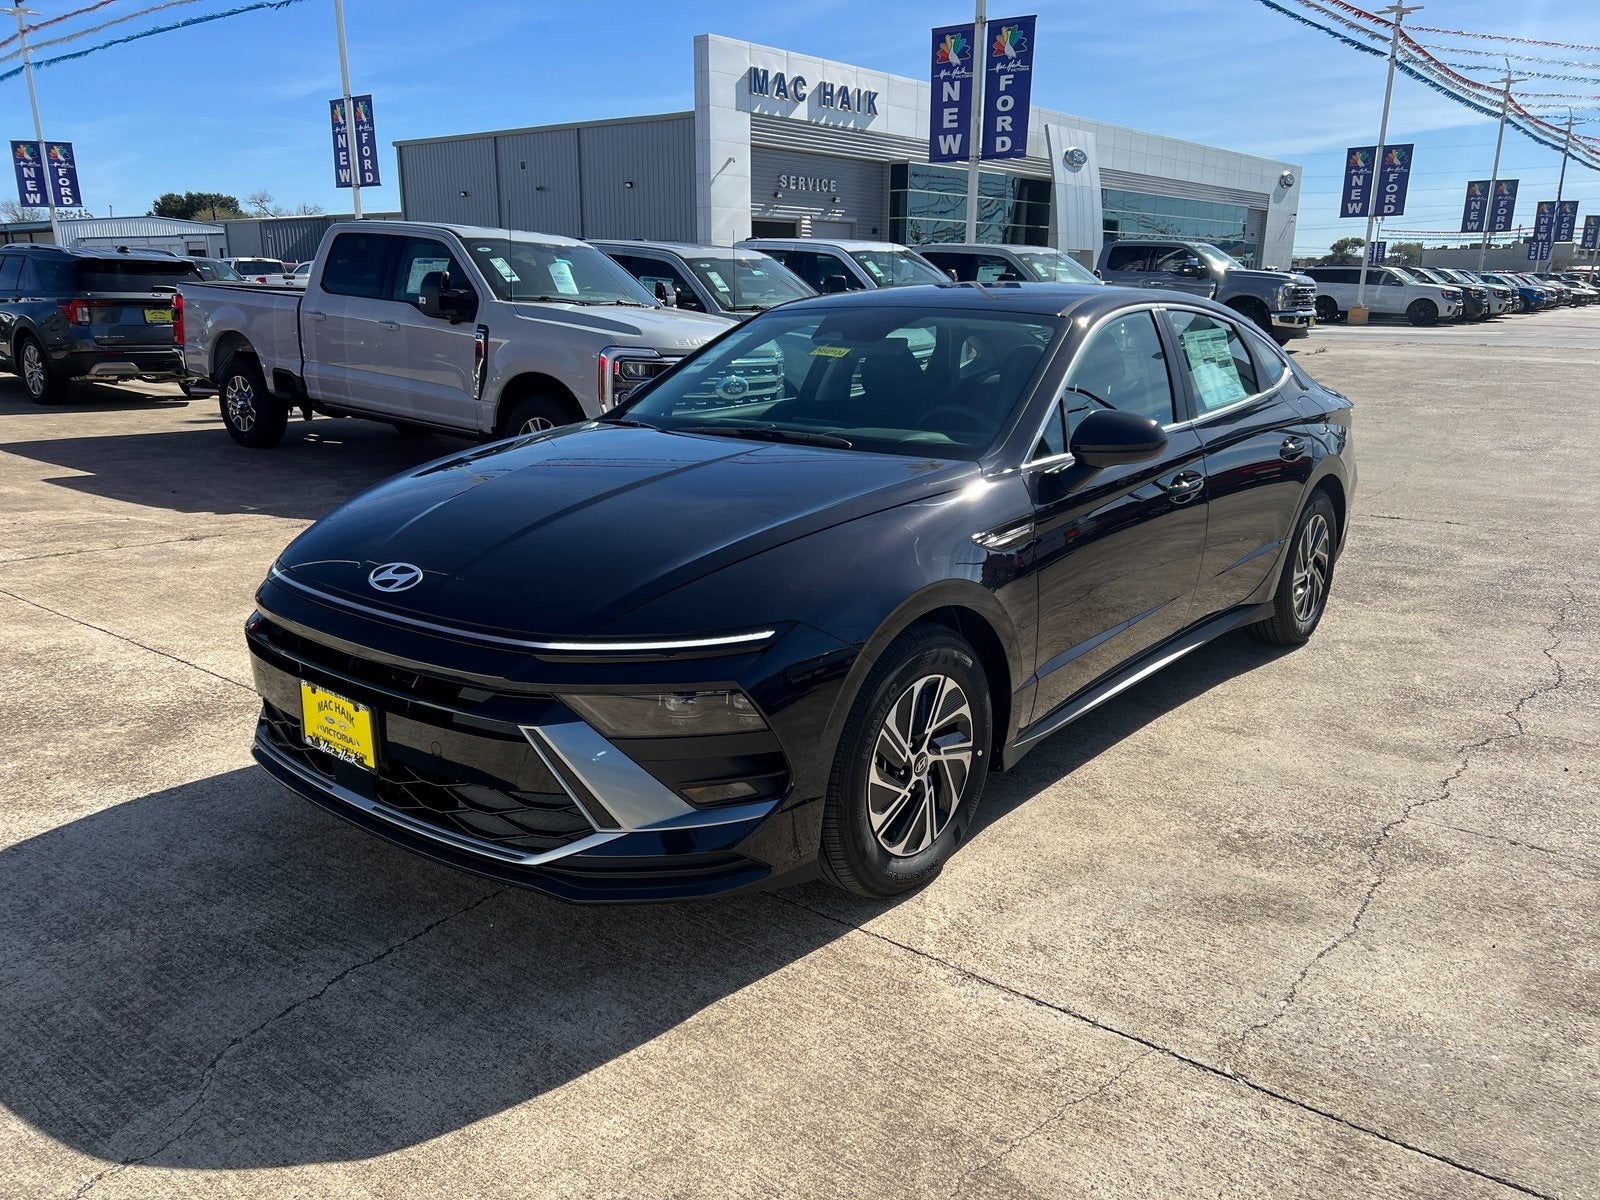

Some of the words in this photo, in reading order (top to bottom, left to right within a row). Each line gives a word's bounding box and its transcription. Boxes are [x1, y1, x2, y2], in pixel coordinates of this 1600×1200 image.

[751, 66, 807, 102] MAC
[821, 81, 879, 116] HAIK
[938, 80, 962, 154] NEW
[996, 74, 1014, 152] FORD
[338, 134, 350, 182] NEW
[362, 133, 373, 182] FORD
[23, 168, 40, 204] NEW
[58, 168, 73, 204] FORD
[780, 175, 836, 192] SERVICE
[1348, 175, 1363, 214] NEW
[1384, 174, 1398, 213] FORD
[1467, 201, 1480, 230] NEW
[1495, 201, 1508, 230] FORD
[1538, 218, 1548, 240] NEW
[1560, 217, 1570, 240] FORD
[1584, 229, 1594, 247] NEW
[318, 700, 333, 712] MAC
[334, 700, 355, 727] HAIK
[320, 741, 335, 755] Mac
[338, 750, 361, 766] Haik
